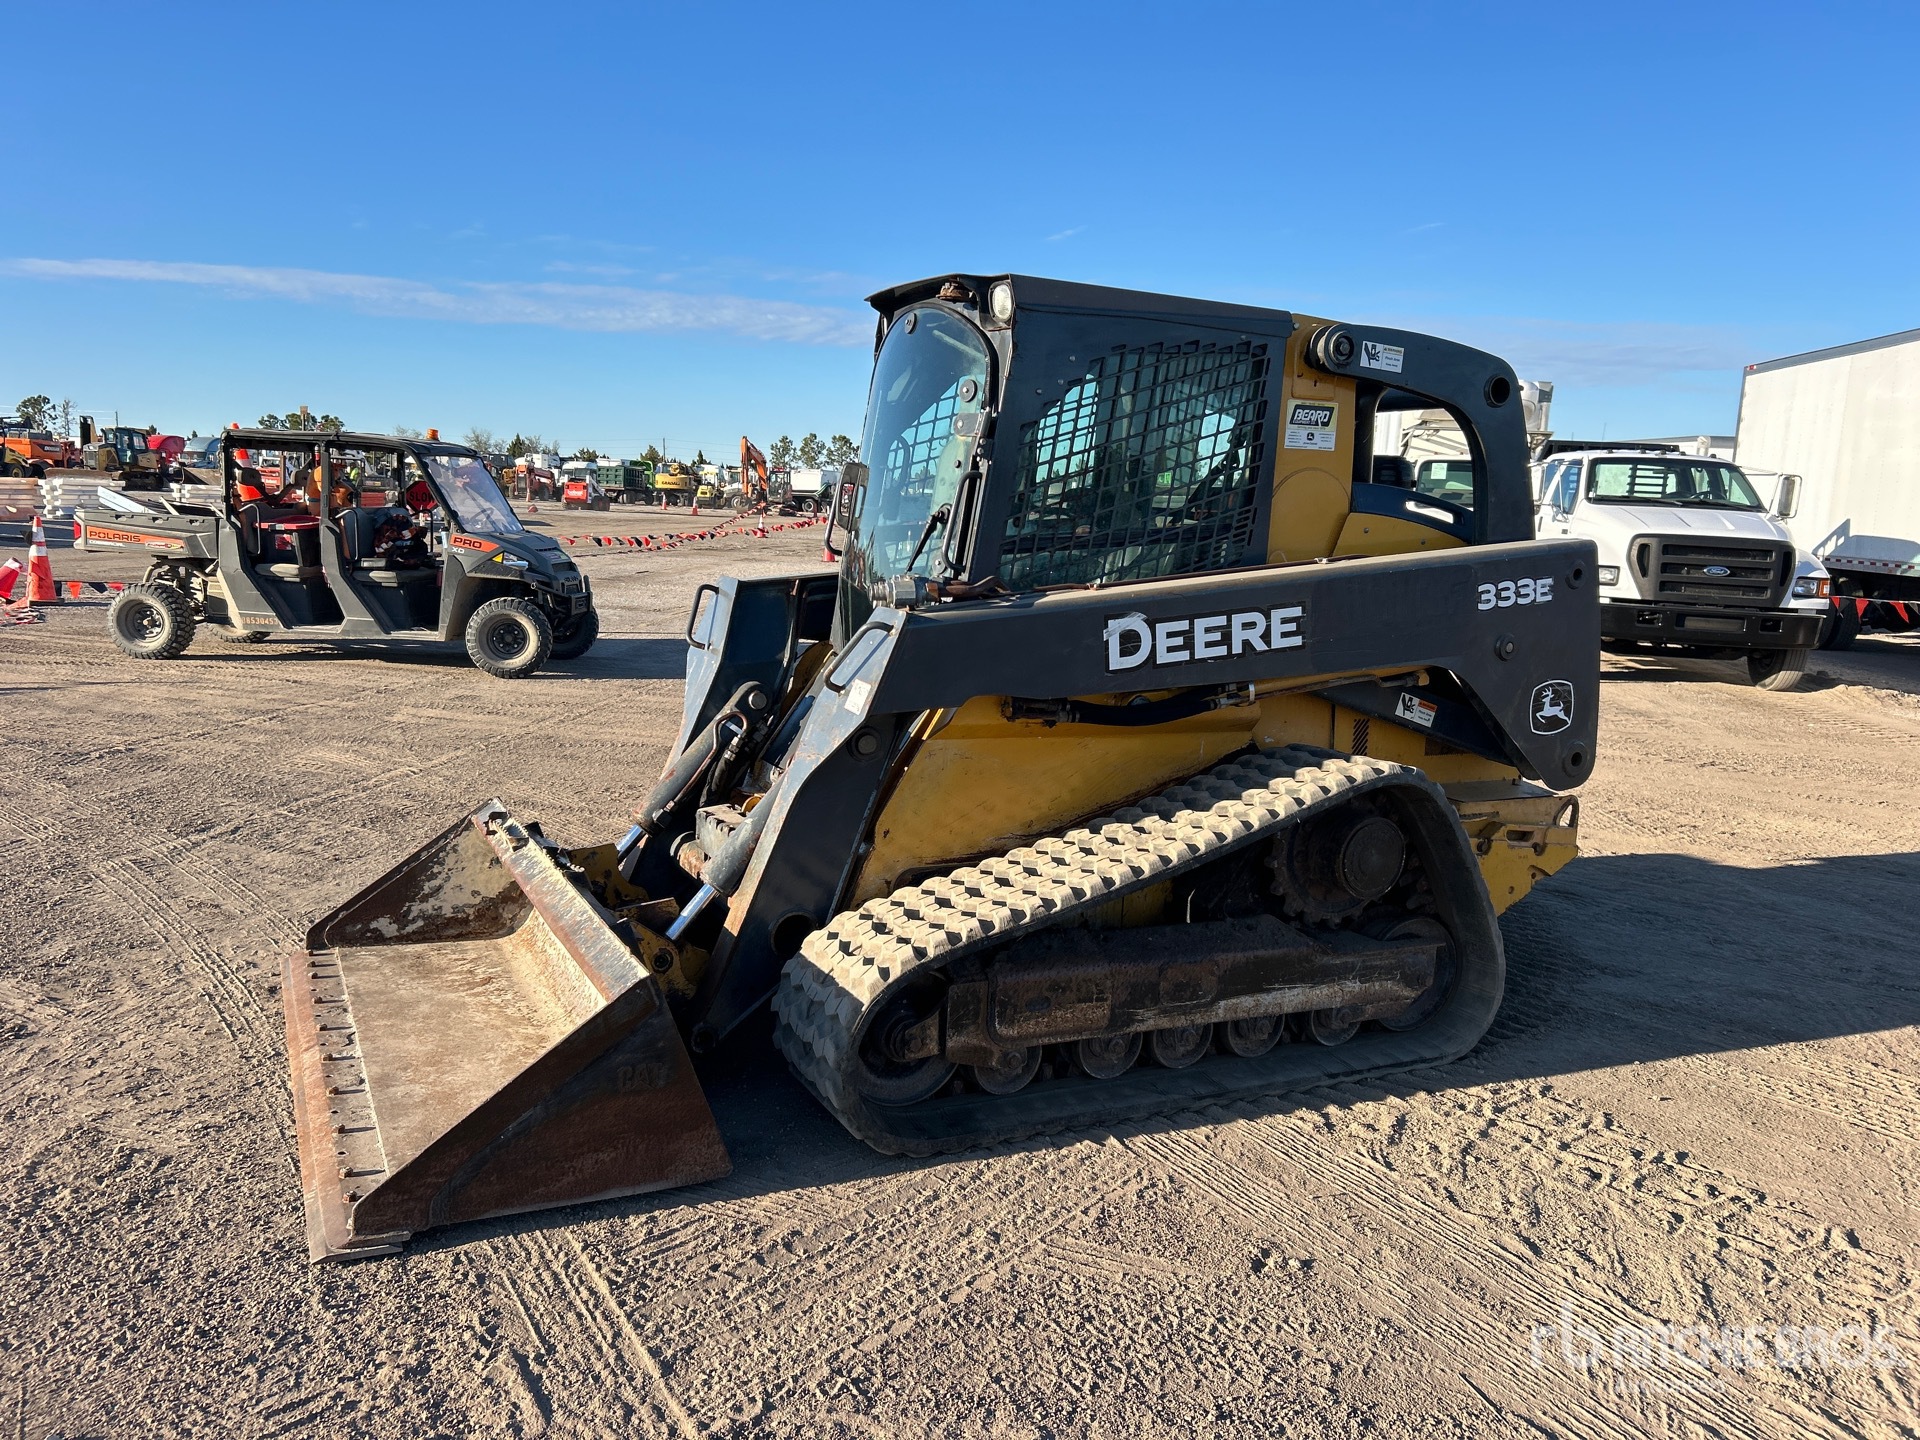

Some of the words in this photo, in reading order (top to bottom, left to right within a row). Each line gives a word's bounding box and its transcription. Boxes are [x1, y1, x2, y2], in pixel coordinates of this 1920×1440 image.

[1294, 409, 1330, 426] BEARD
[89, 530, 141, 543] POLARIS
[453, 536, 482, 549] PRO
[451, 546, 465, 554] XD
[1477, 577, 1553, 611] 333E
[1104, 606, 1304, 671] DEERE
